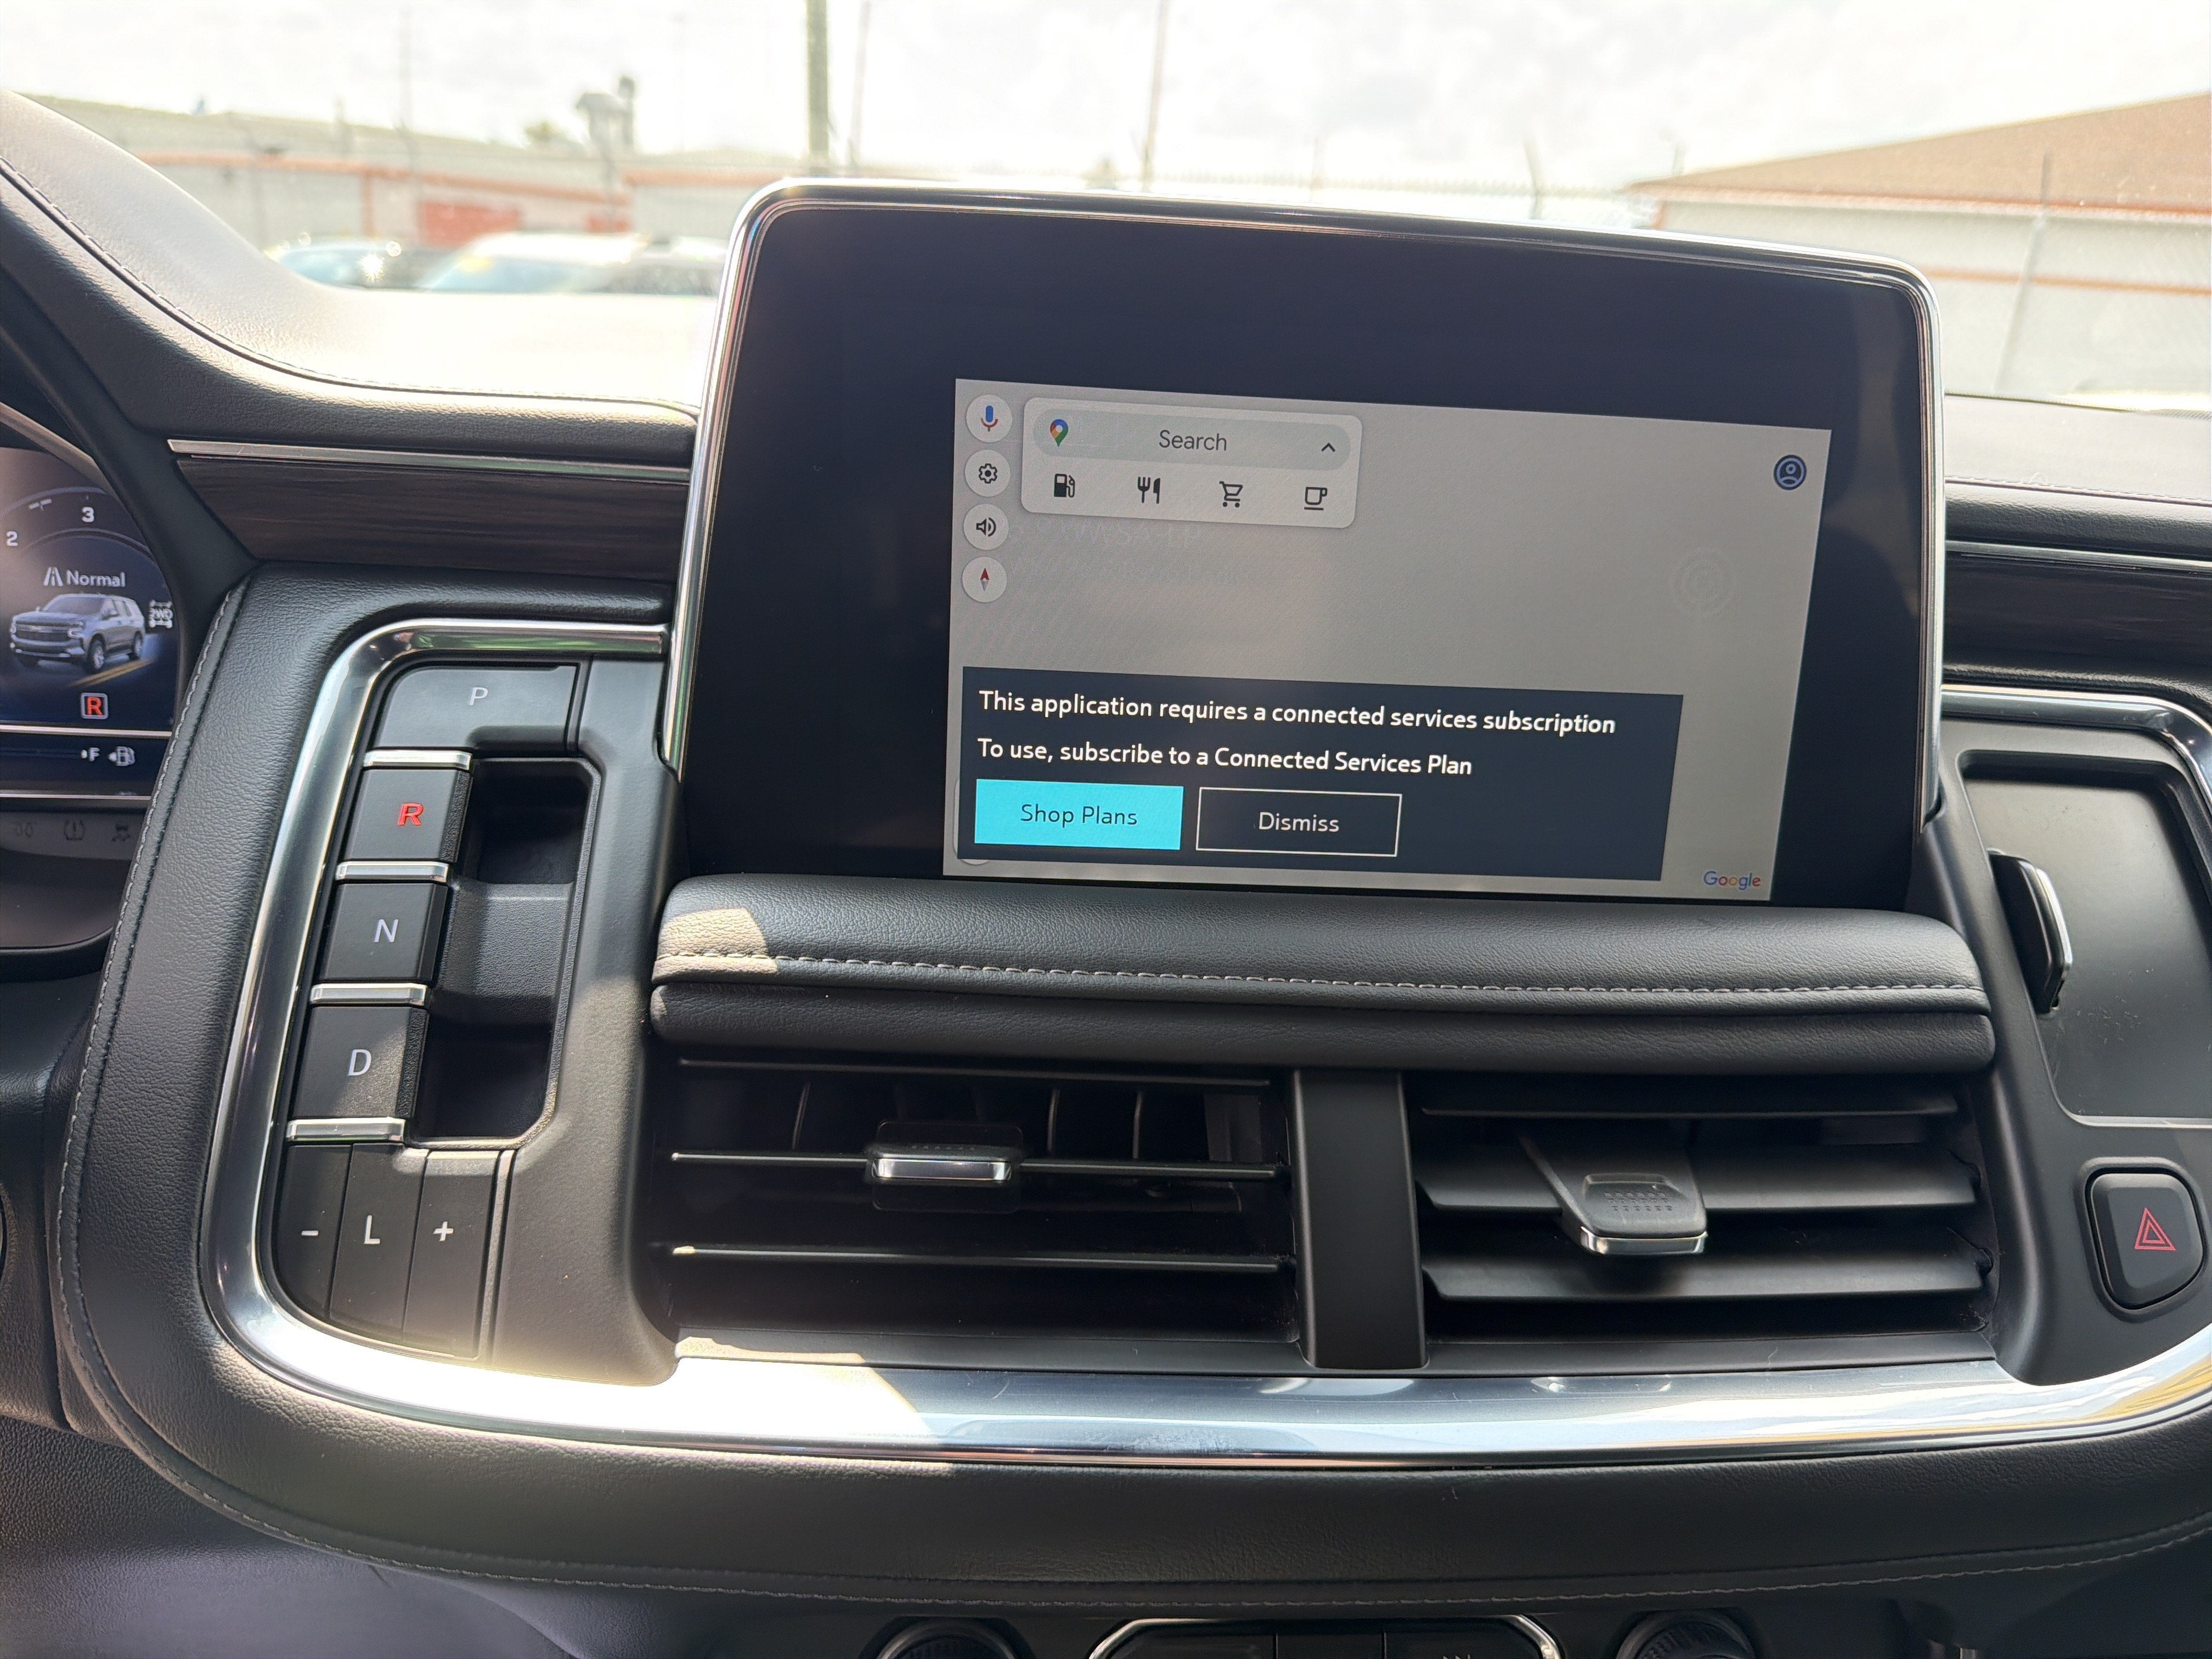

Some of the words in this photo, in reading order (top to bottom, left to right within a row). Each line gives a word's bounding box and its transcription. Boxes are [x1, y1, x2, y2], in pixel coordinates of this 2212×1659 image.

[1159, 430, 1227, 452] Search
[82, 506, 94, 523] 3
[6, 531, 18, 546] 2
[66, 569, 126, 588] Normal
[87, 696, 103, 716] R
[469, 687, 488, 706] P
[979, 690, 1025, 711] This
[1031, 693, 1152, 719] application
[1160, 700, 1248, 724] requires
[1254, 707, 1266, 721] a
[1272, 706, 1385, 725] connected
[1390, 709, 1477, 729] services
[1482, 710, 1616, 738] subscription
[89, 747, 100, 761] F
[977, 738, 1003, 758] To
[1010, 744, 1053, 763] use,
[1060, 741, 1163, 764] subscribe
[1168, 747, 1190, 765] to
[1196, 752, 1209, 765] a
[1215, 747, 1329, 770] Connected
[1334, 752, 1421, 773] Services
[1427, 754, 1472, 775] Plan
[398, 803, 424, 826] R
[1020, 803, 1074, 828] Shop
[1082, 805, 1137, 826] Plans
[1258, 811, 1340, 833] Dismiss
[1703, 870, 1762, 891] Google
[374, 919, 399, 943] N
[347, 1049, 373, 1076] D
[363, 1215, 381, 1245] L
